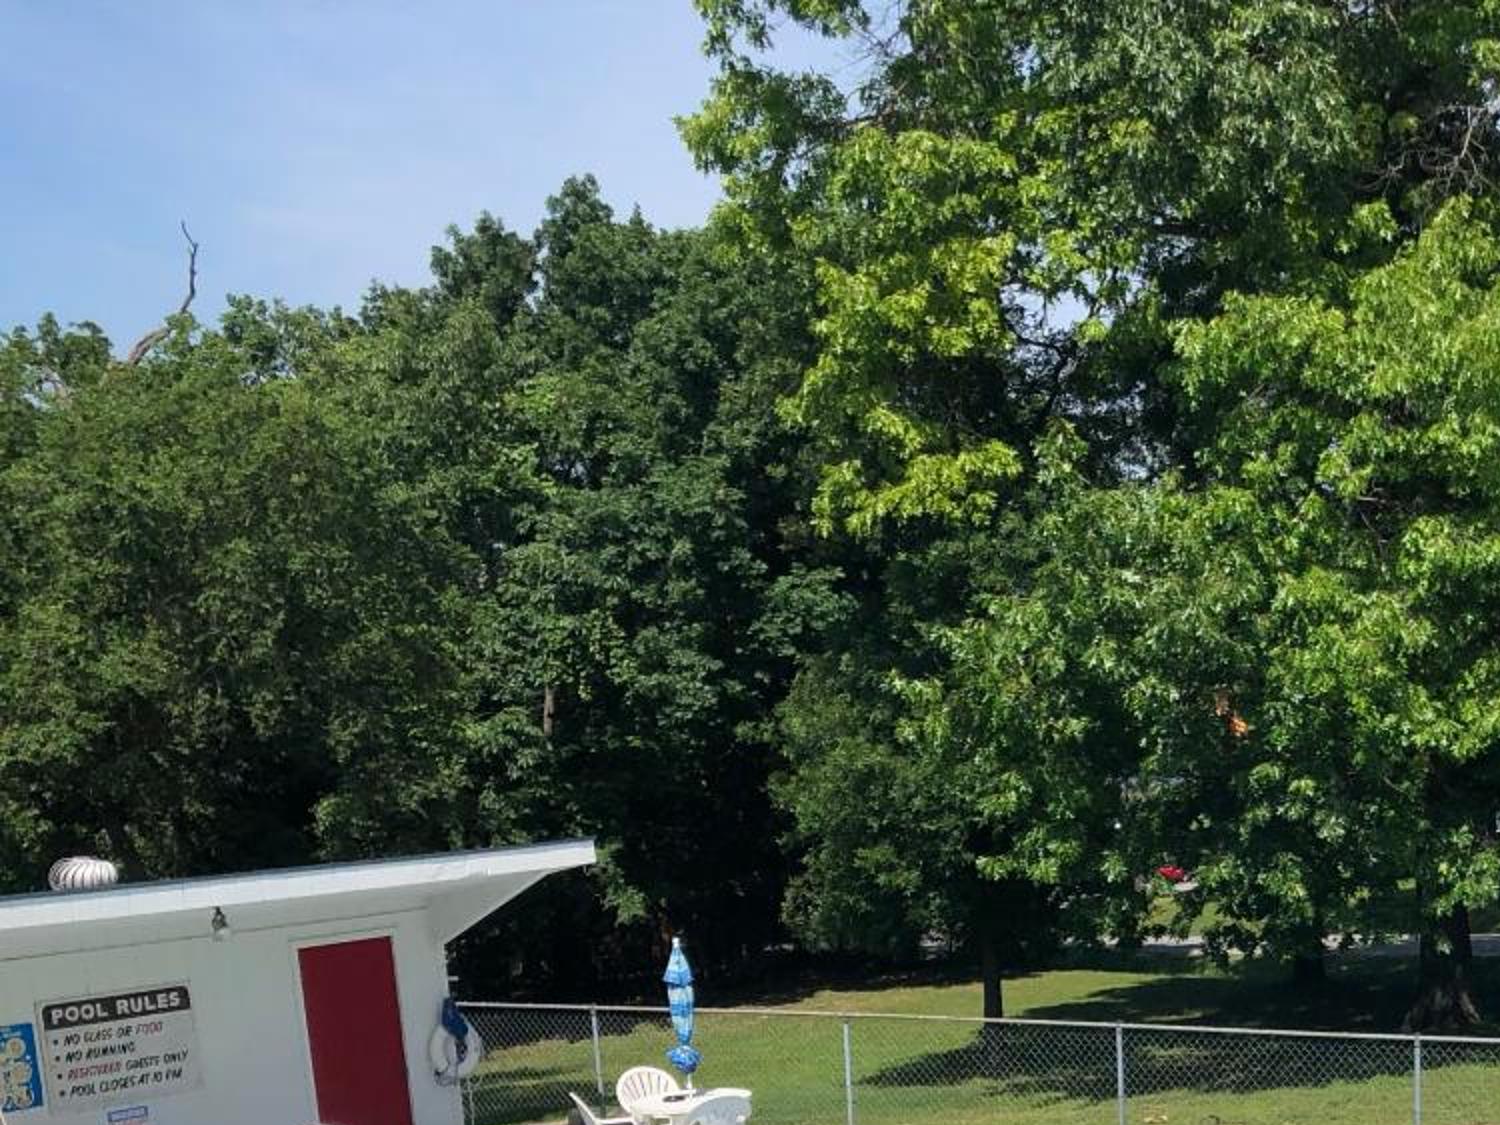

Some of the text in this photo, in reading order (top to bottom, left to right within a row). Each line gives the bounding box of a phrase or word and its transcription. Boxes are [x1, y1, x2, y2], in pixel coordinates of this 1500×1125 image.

[51, 991, 180, 1025] POOL RULES
[64, 1033, 81, 1047] NO
[84, 1028, 112, 1043] GLASS
[66, 1041, 135, 1063] NO RUNNING
[125, 1055, 160, 1071] GUESTS
[163, 1048, 189, 1064] ONLY
[70, 1083, 96, 1098] POOL
[100, 1075, 137, 1093] CLOSES
[138, 1072, 151, 1085] AT
